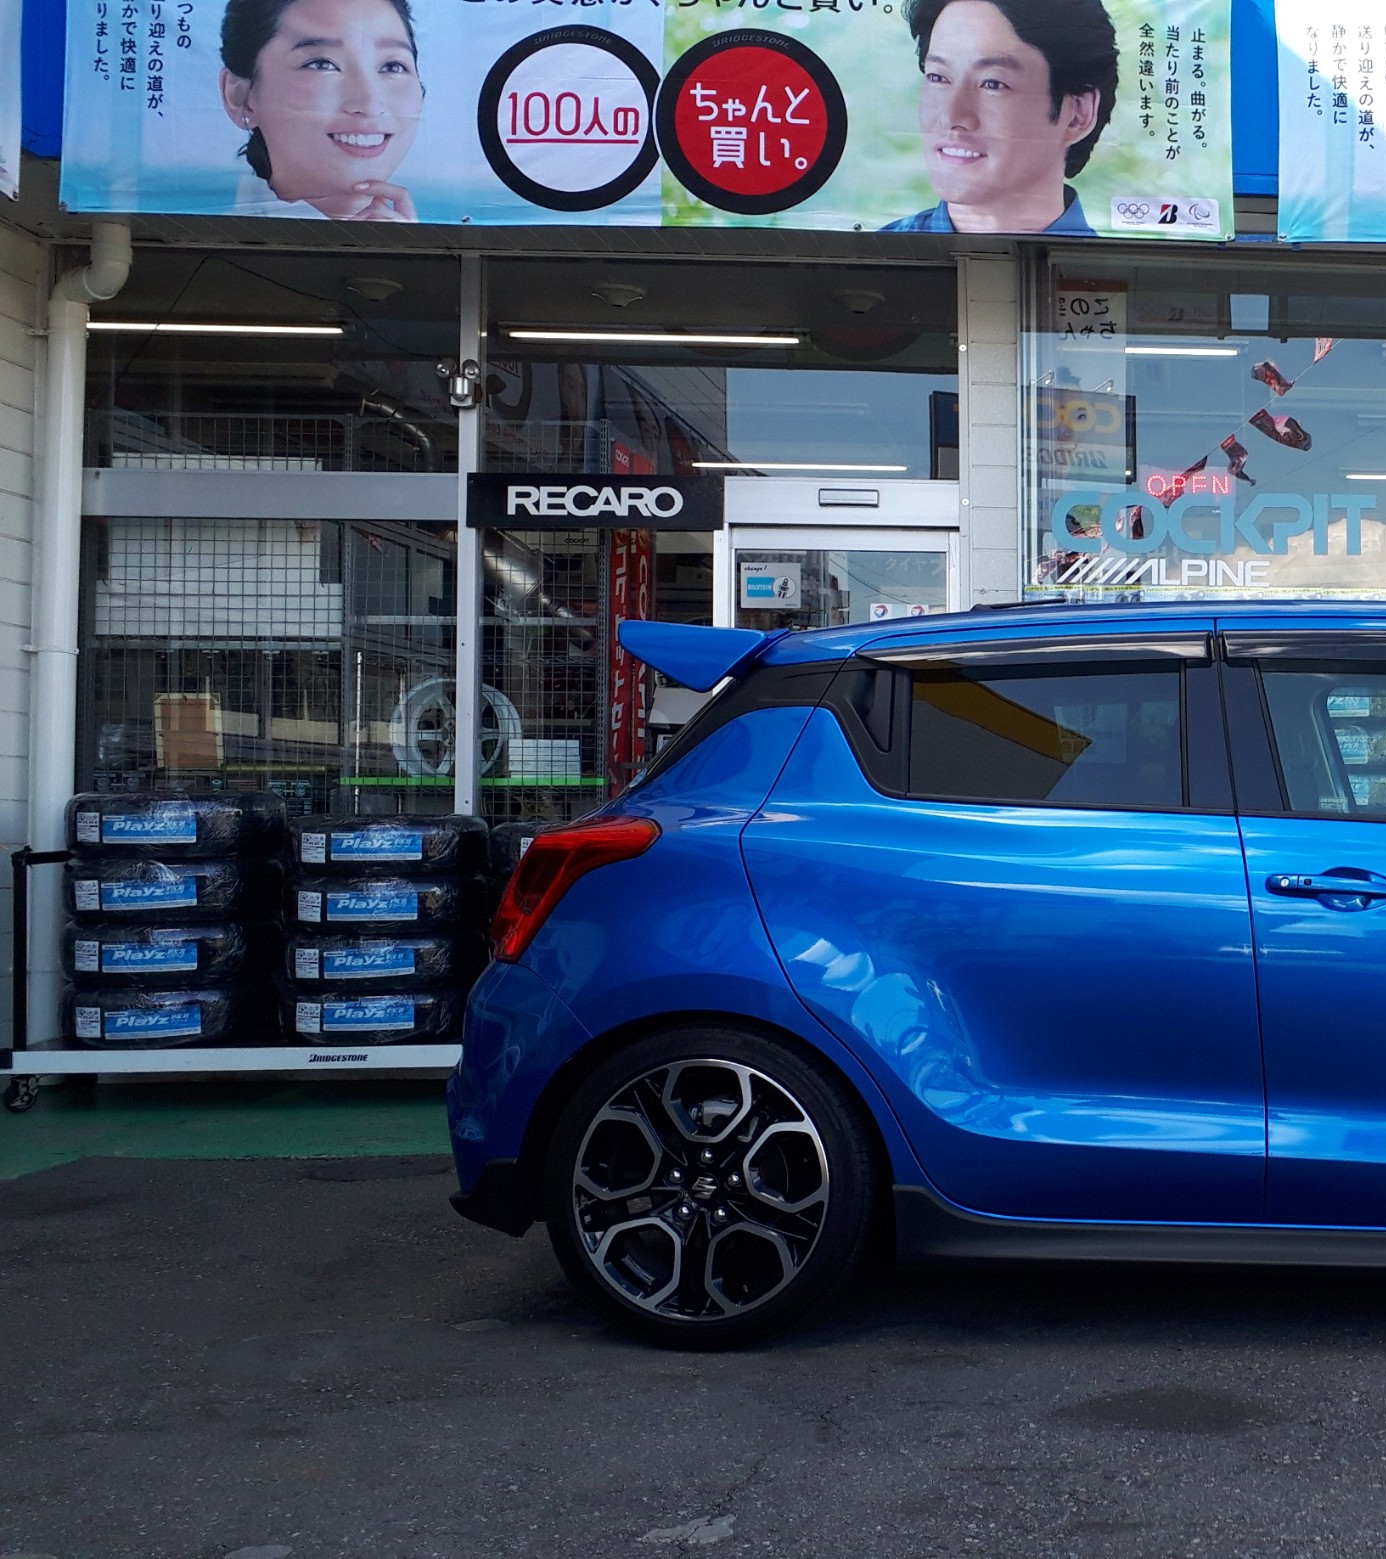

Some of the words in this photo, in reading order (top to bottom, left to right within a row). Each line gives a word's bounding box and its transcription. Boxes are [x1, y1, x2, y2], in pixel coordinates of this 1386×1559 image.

[120, 0, 138, 90] かで快適に
[534, 30, 612, 45] BRIDGESTONE
[712, 34, 791, 49] BRIDGESTONE
[147, 0, 166, 117] り迎えの道が、
[1306, 25, 1323, 116] なりました。
[1138, 22, 1155, 137] 全然違います。
[1190, 28, 1208, 149] 止まる。曲がる。
[1331, 24, 1348, 125] 静かで快適に
[1357, 25, 1375, 149] 送り迎えの道が、
[690, 82, 810, 125] ちゃんと
[1165, 25, 1181, 160] 当たり前のことが
[507, 91, 640, 136] 100人の
[711, 126, 808, 170] 買い。
[1146, 474, 1231, 497] OPEN
[507, 485, 684, 518] RECARO
[1051, 490, 1376, 556] COCKPIT
[1125, 558, 1270, 587] ALPINE
[112, 821, 164, 831] Playz
[341, 838, 392, 848] Playz
[112, 887, 164, 898] Playz
[336, 898, 388, 909] Playz
[112, 949, 166, 960] Playz
[333, 955, 385, 967] Playz
[115, 1016, 170, 1027] Playz
[334, 1007, 385, 1019] Playz
[309, 1053, 368, 1063] BRIDGESTONE
